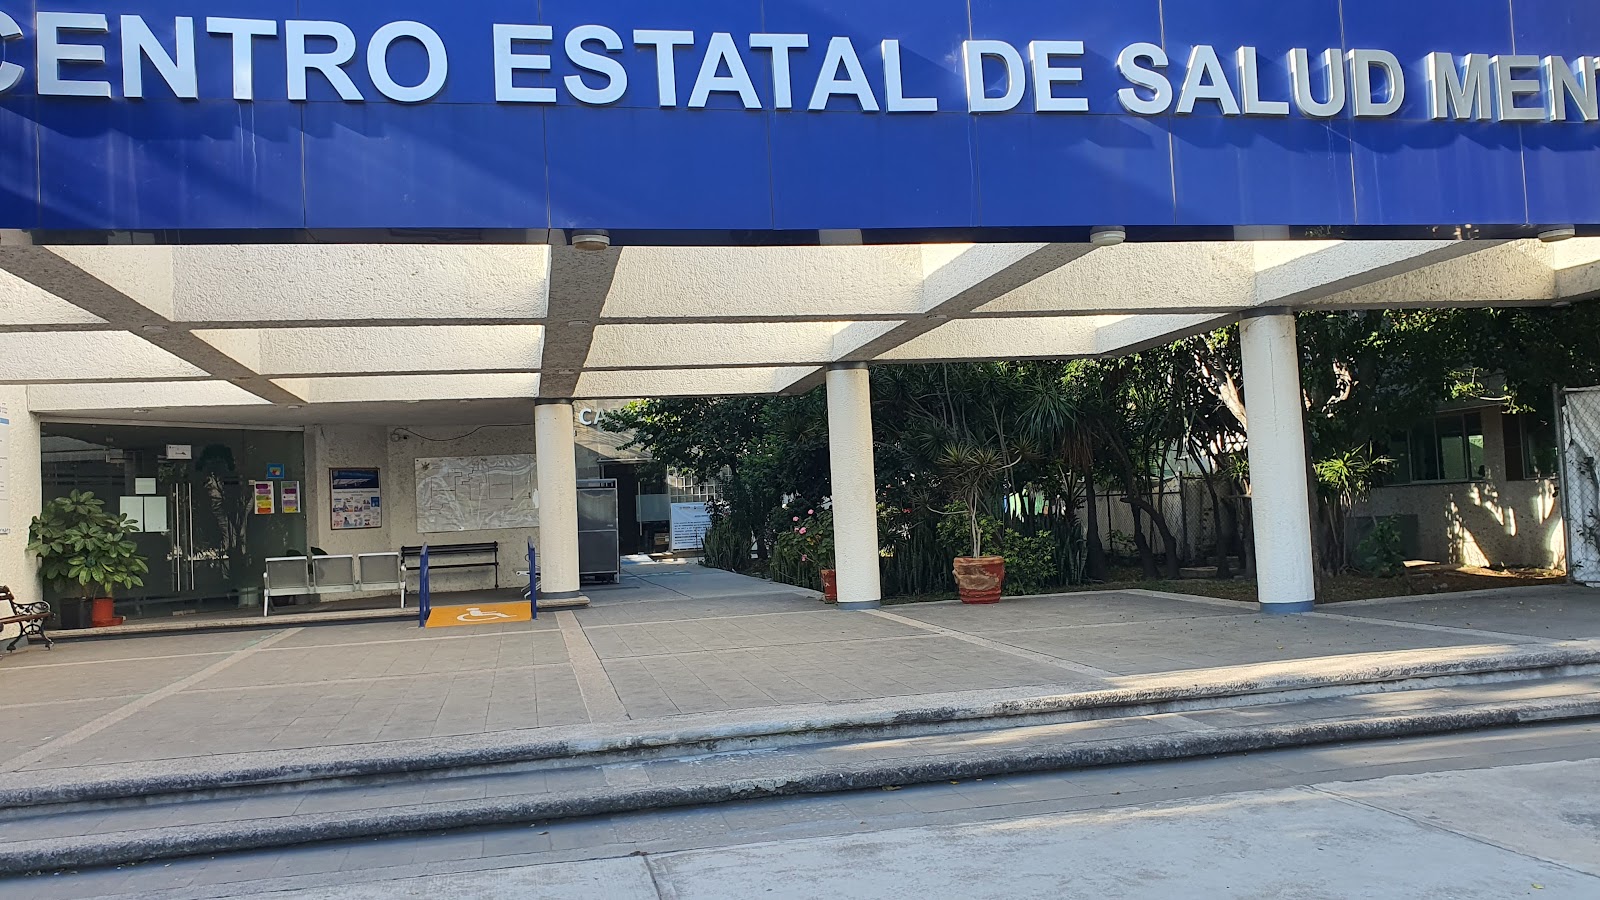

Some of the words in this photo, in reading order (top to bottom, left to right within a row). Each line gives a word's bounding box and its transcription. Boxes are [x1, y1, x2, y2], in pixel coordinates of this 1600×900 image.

[493, 23, 938, 114] ESTATAL
[962, 39, 1089, 114] DE
[1117, 42, 1405, 118] SALUD
[1426, 52, 1600, 122] MEN
